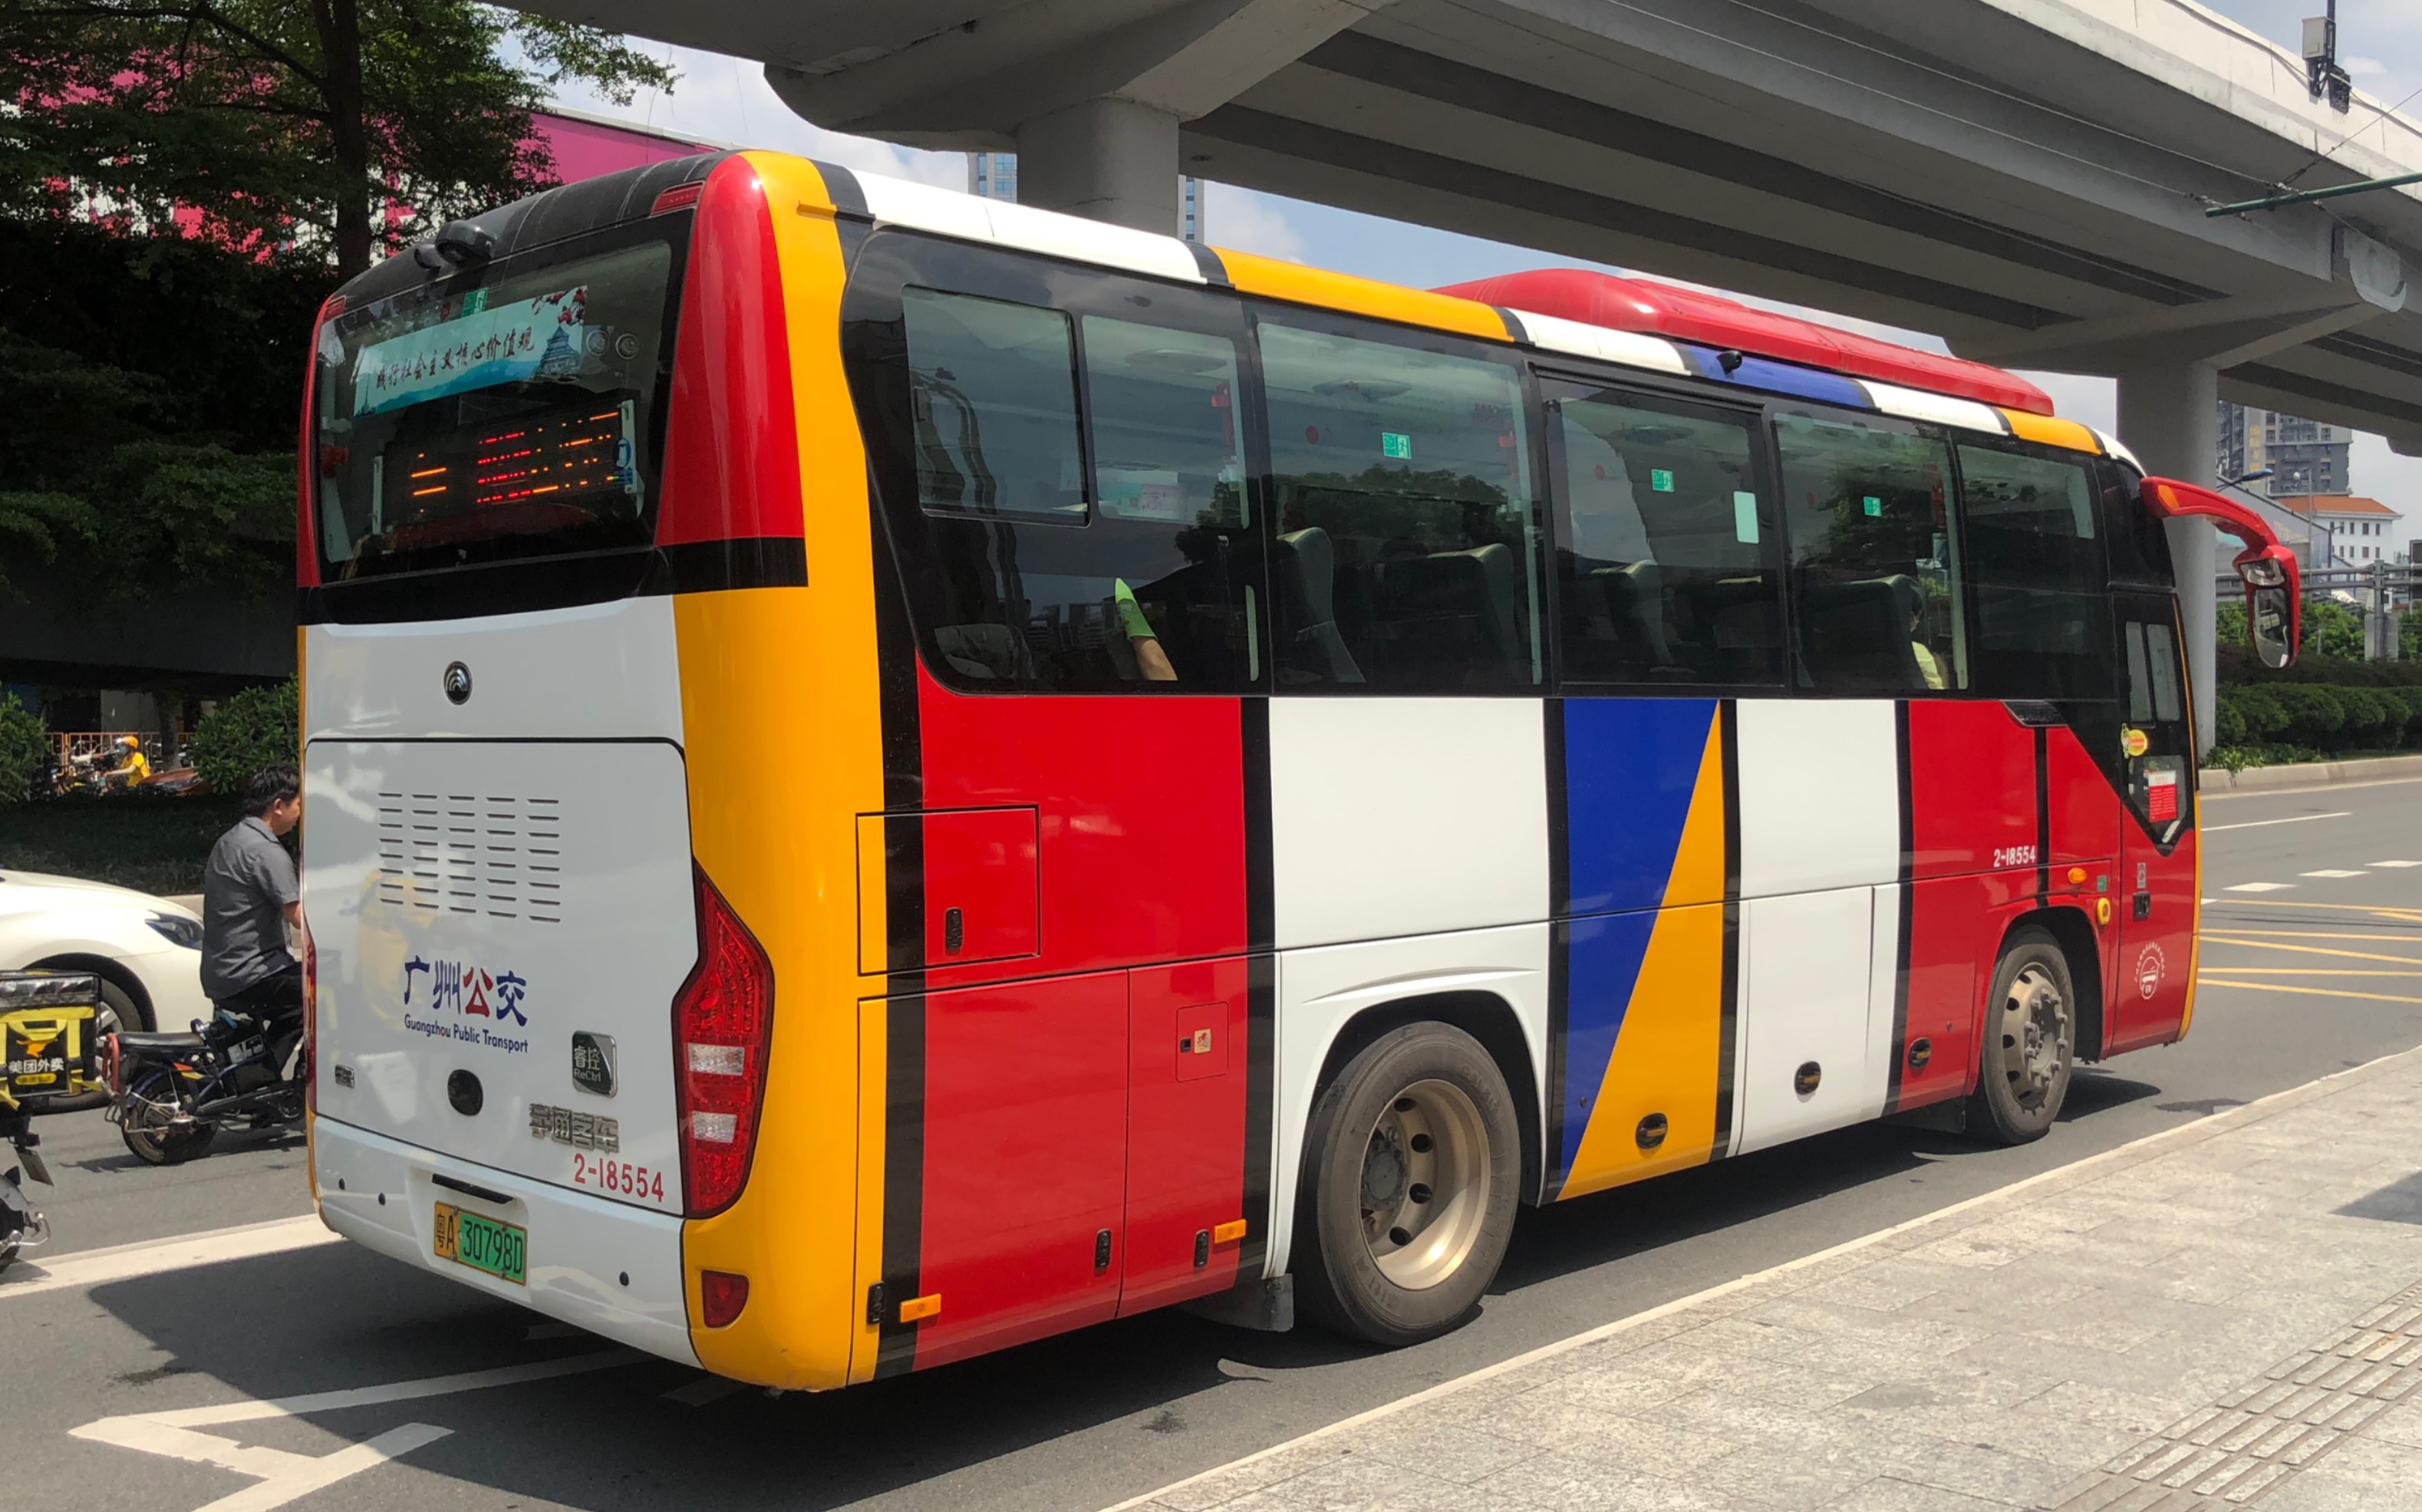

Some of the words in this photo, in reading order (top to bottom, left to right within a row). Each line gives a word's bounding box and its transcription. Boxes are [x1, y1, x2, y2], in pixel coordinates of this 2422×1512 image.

[1993, 845, 2036, 868] 2-18554
[404, 954, 528, 1027] 广州公交
[404, 1013, 451, 1038] Guangzhou
[453, 1023, 480, 1044] Public
[482, 1029, 529, 1054] Transport
[8, 1057, 64, 1074] 美团外卖
[574, 1044, 601, 1071] 睿控
[574, 1068, 601, 1082] ReCtrl
[529, 1102, 620, 1155] 宇通客车
[574, 1153, 664, 1203] 2-18554
